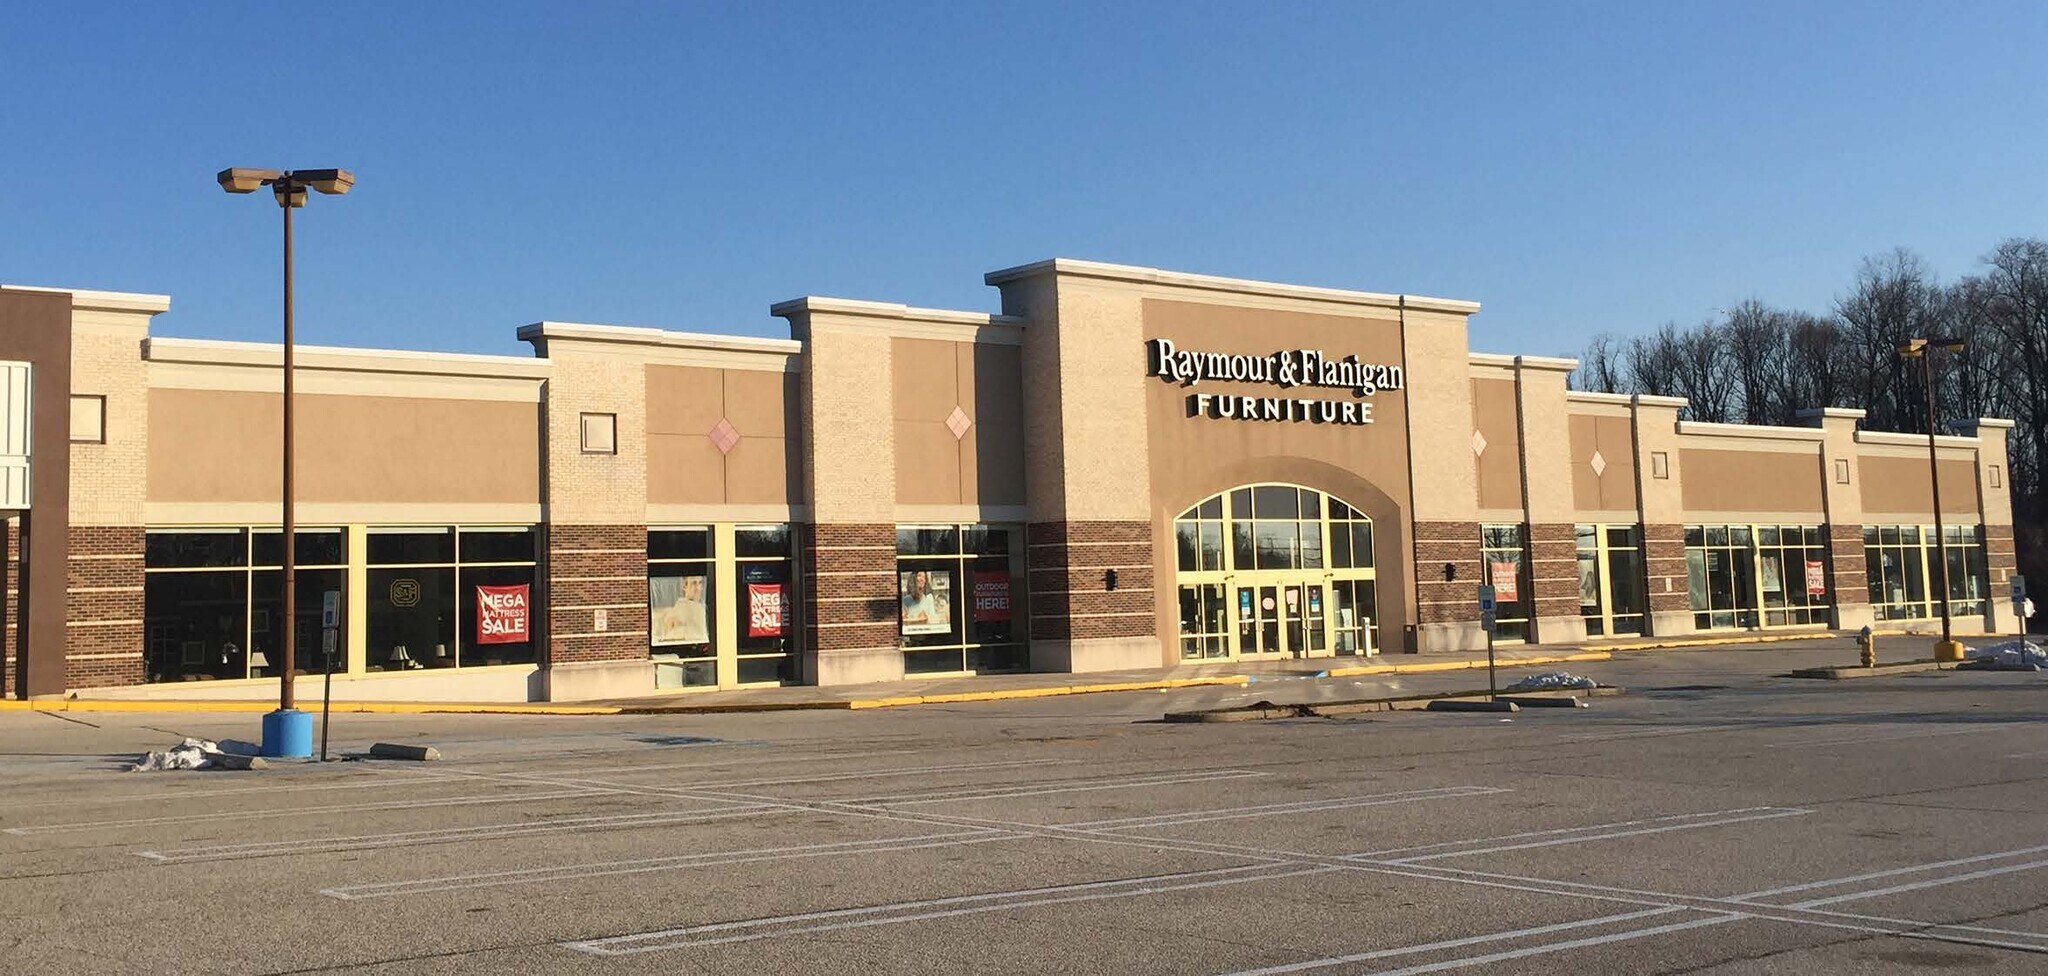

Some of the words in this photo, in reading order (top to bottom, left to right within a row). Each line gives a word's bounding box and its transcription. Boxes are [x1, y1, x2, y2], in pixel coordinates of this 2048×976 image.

[1157, 338, 1277, 386] Raymour
[1278, 350, 1301, 387] &
[1301, 349, 1404, 397] Flanigan
[1196, 393, 1375, 424] FURNITURE
[481, 593, 525, 608] MEGA
[976, 597, 1010, 610] HERE!
[481, 618, 525, 635] SALE
[751, 613, 790, 628] SALE
